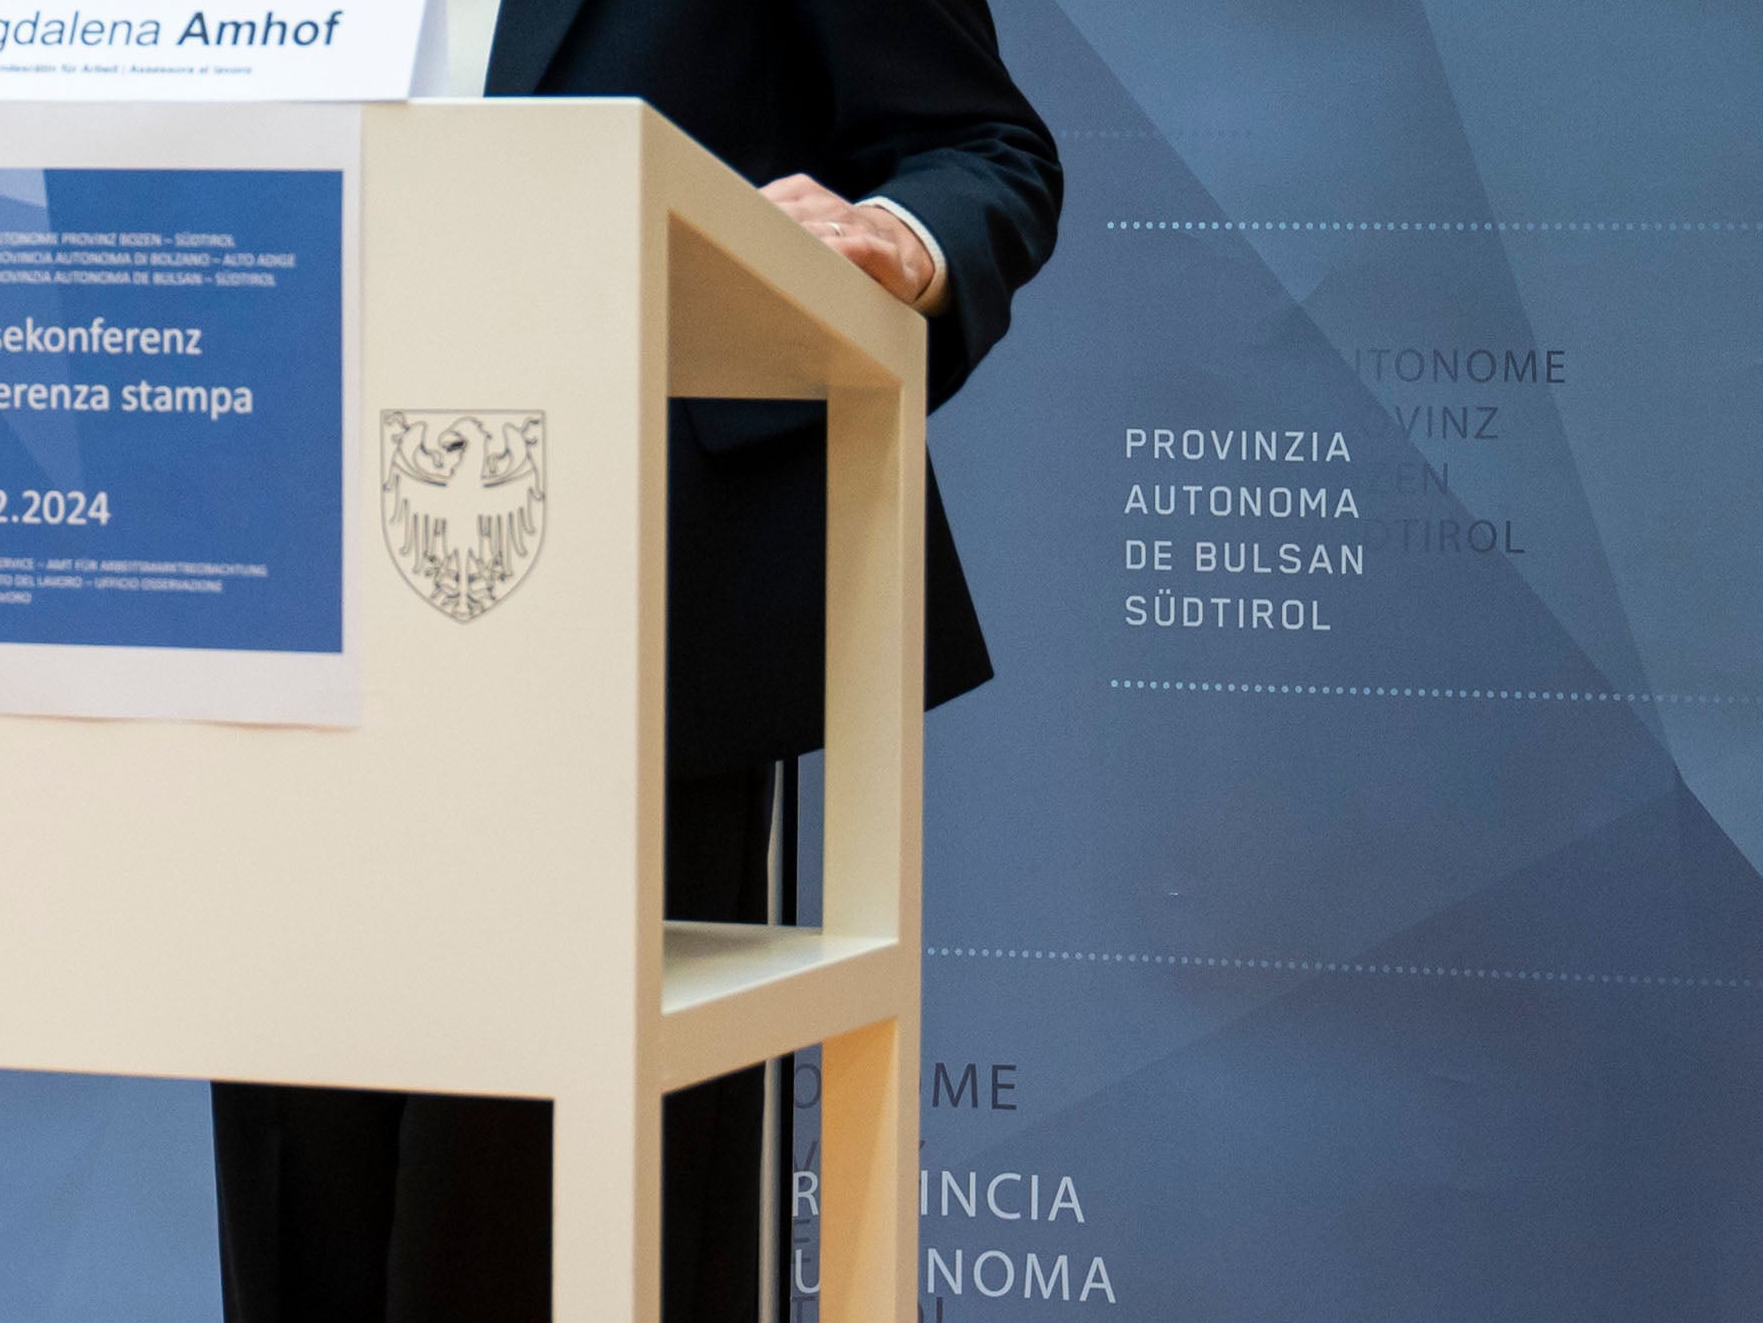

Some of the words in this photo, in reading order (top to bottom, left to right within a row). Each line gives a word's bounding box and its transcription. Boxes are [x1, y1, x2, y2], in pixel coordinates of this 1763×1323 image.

[176, 10, 343, 47] Amhof
[121, 380, 253, 421] stampa
[1125, 428, 1351, 463] PROVINZIA
[1124, 485, 1360, 519] AUTONOMA
[1125, 540, 1173, 570] DE
[1195, 543, 1365, 576] BULSAN
[1125, 588, 1331, 630] SÜDTIROL
